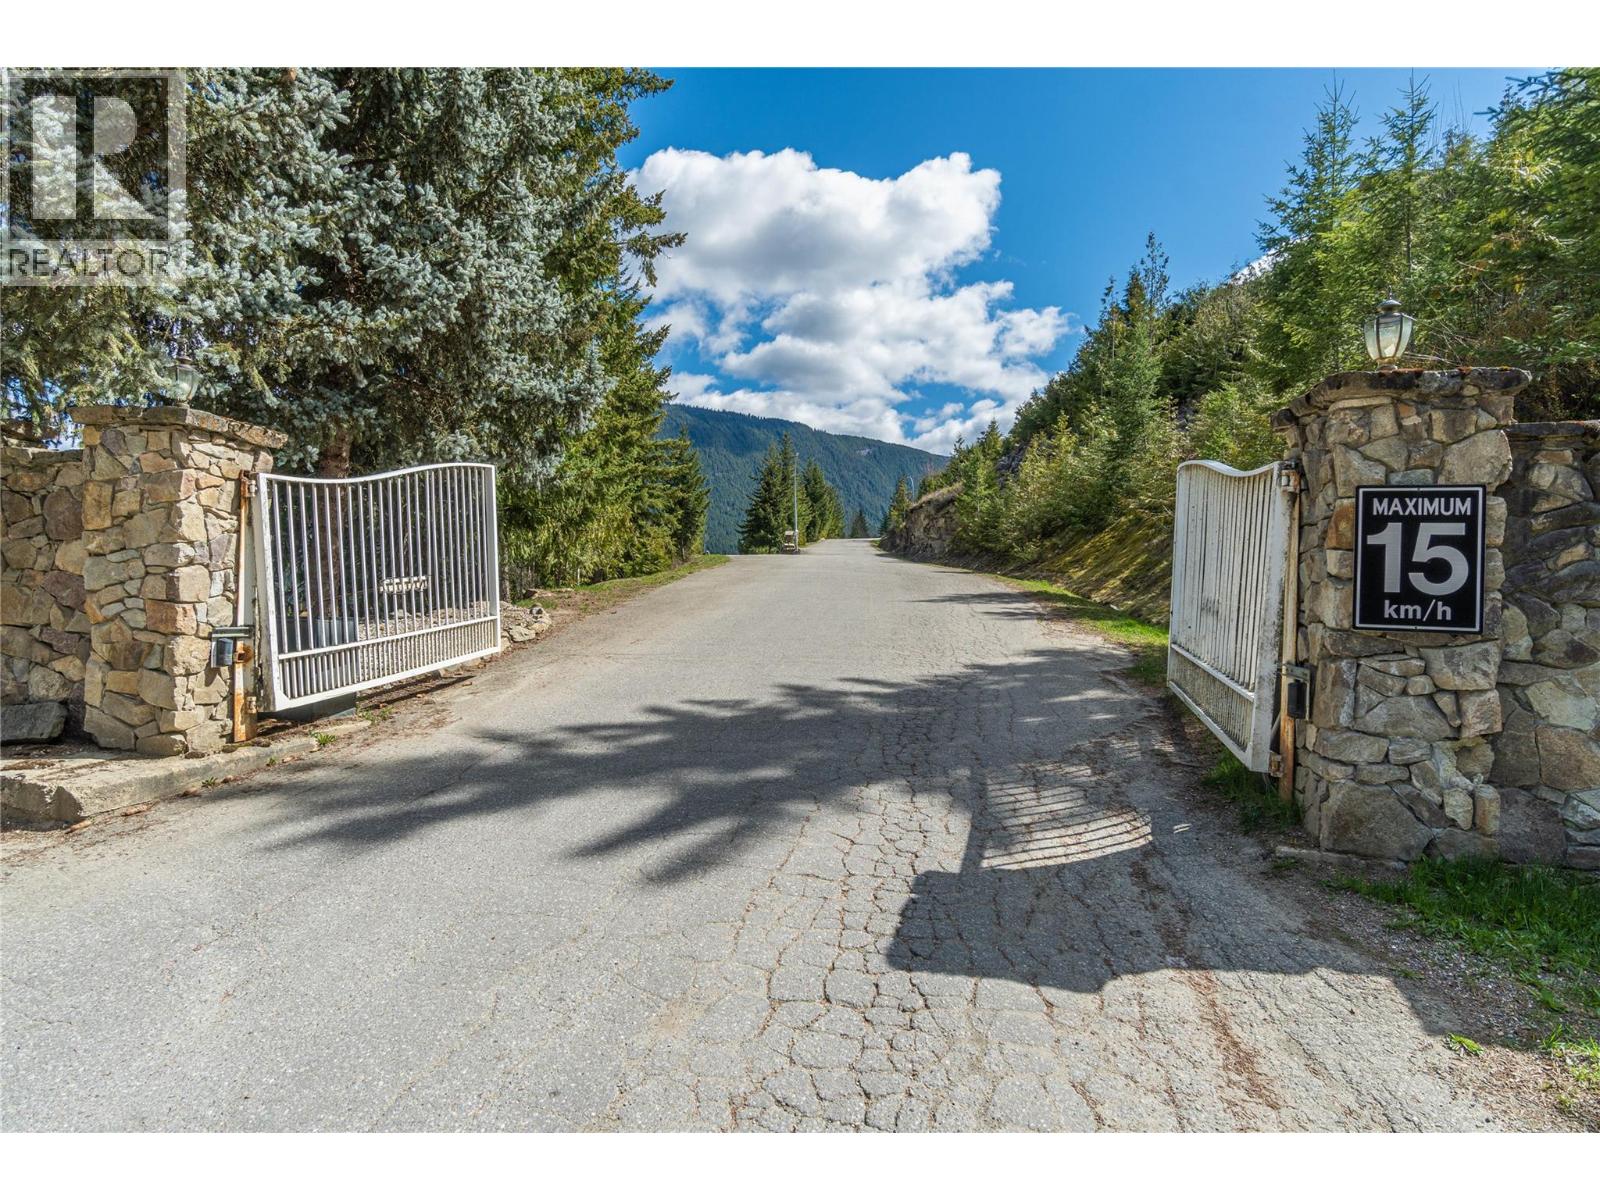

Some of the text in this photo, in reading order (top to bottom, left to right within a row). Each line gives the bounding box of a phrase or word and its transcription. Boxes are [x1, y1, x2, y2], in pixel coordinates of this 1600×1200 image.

[1372, 497, 1472, 516] MAXIMUM
[1366, 522, 1469, 595] 15
[1383, 600, 1451, 622] km/h
